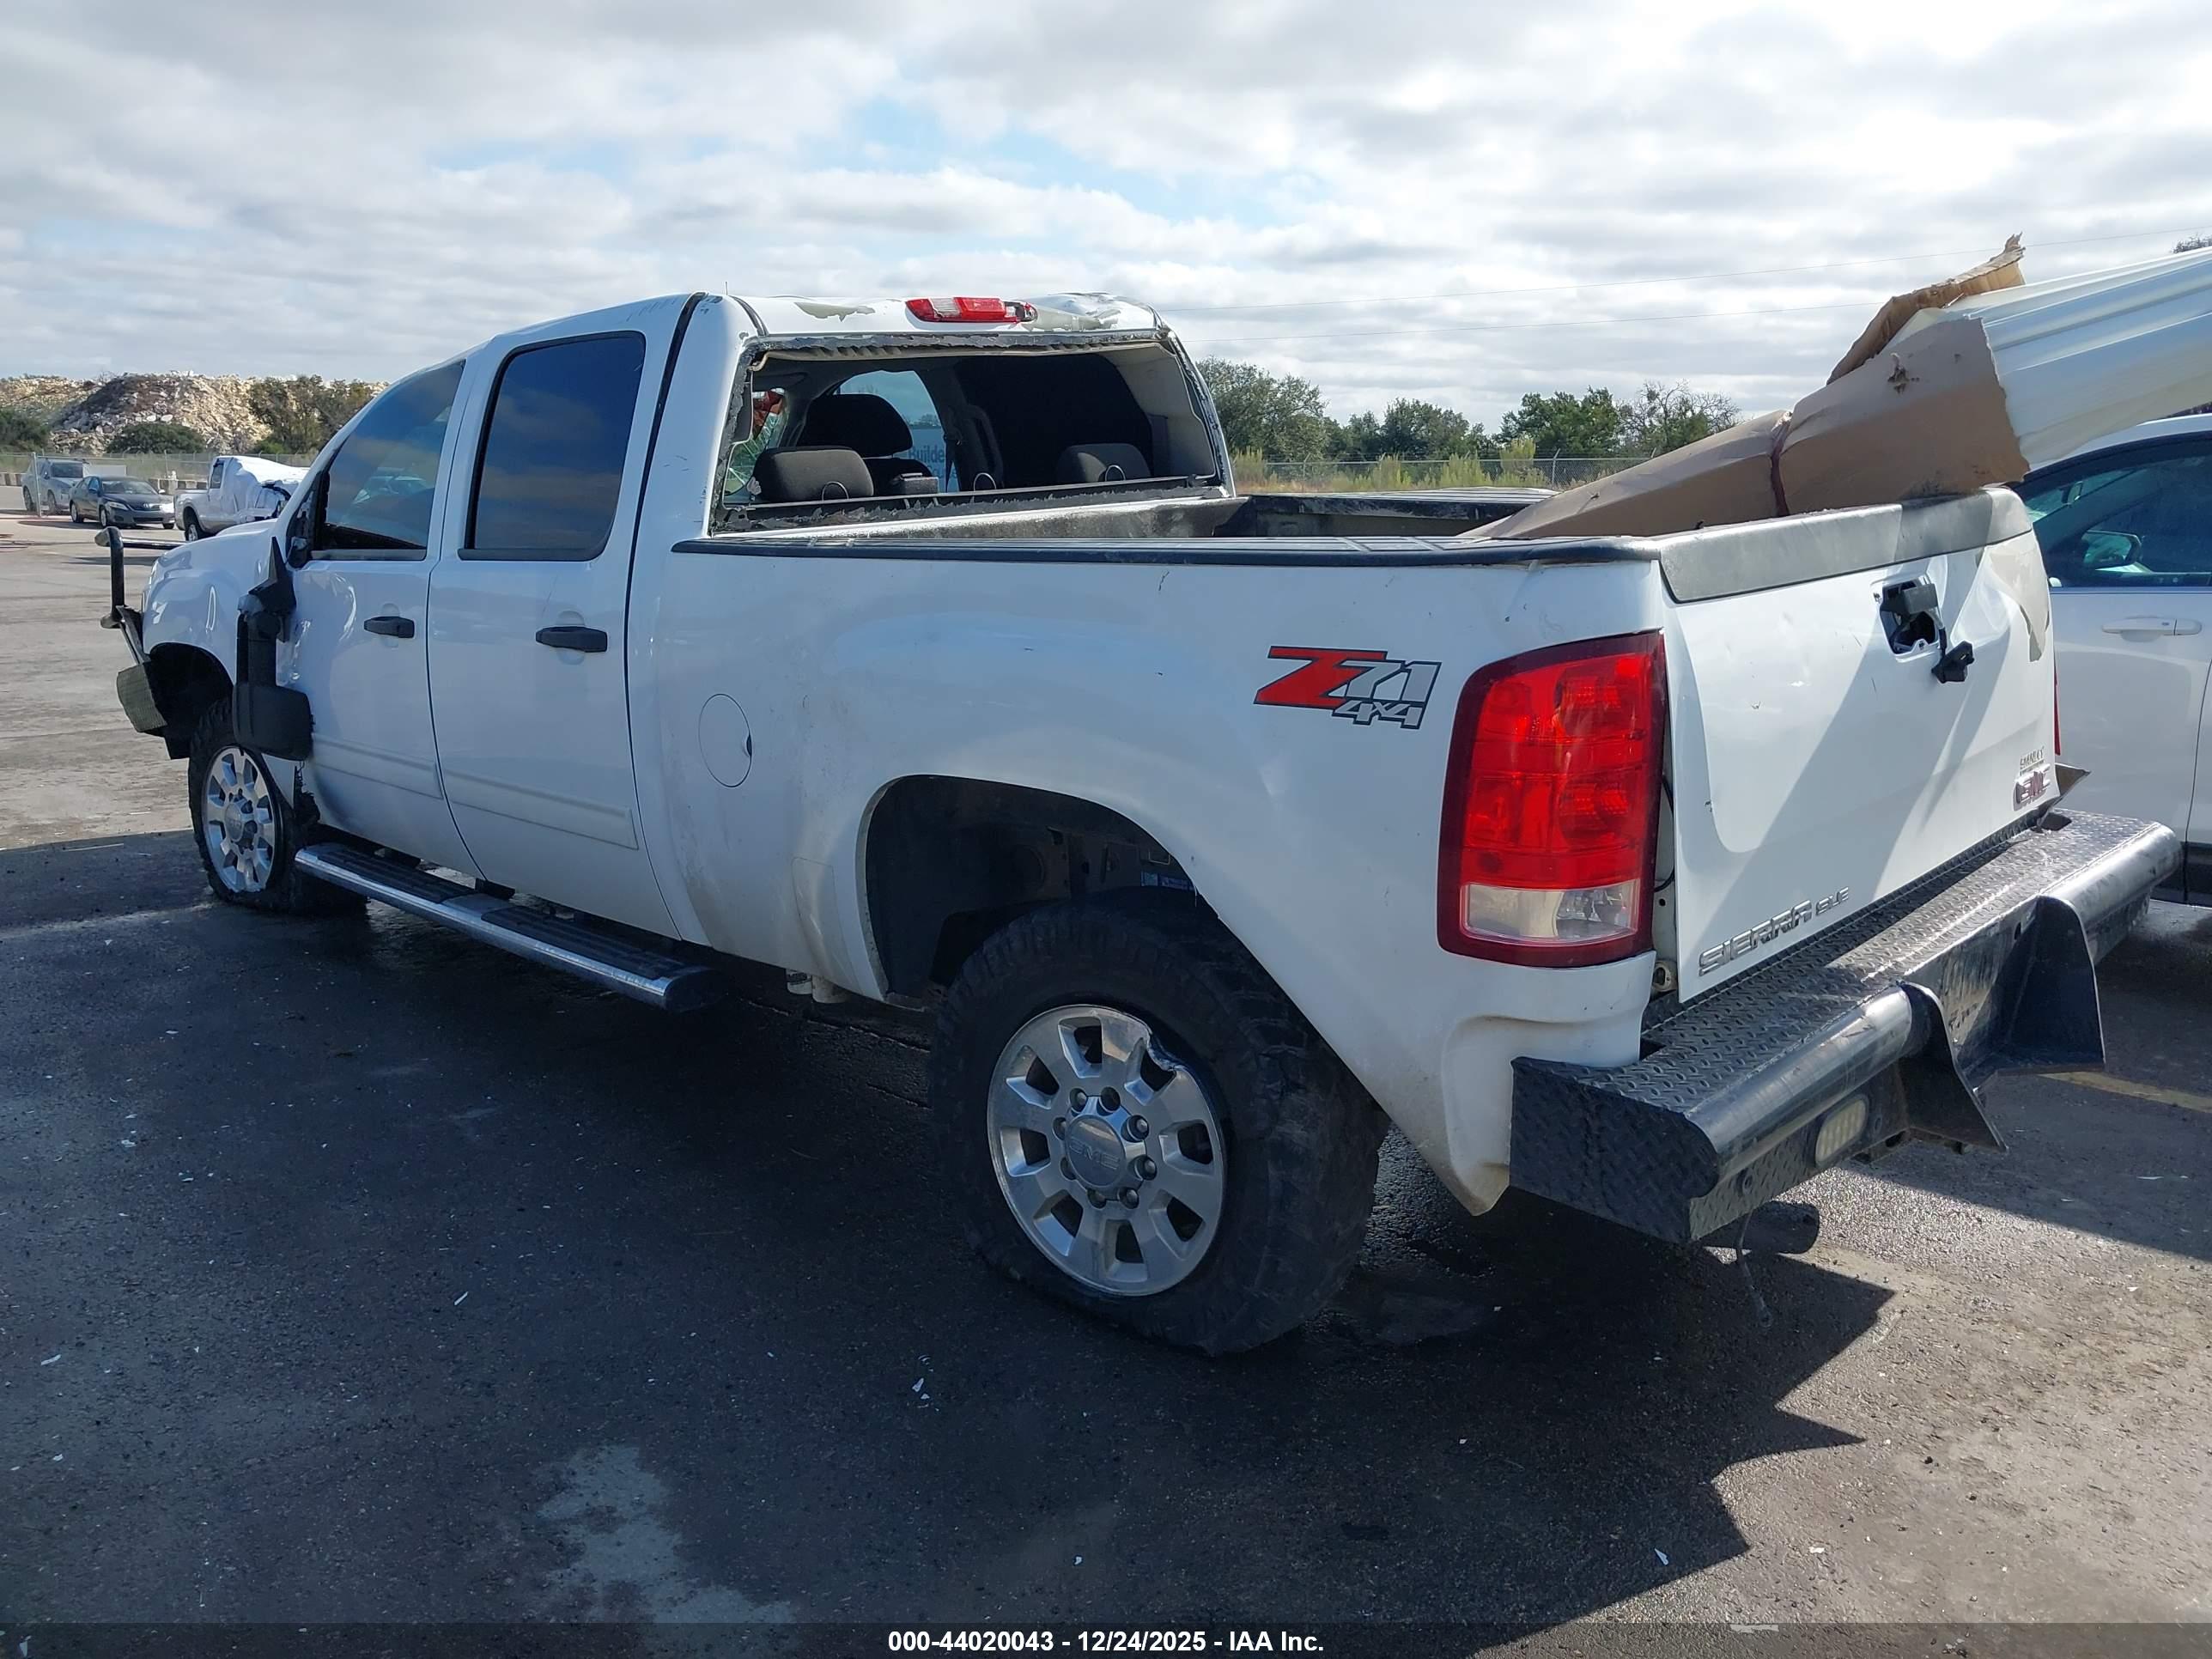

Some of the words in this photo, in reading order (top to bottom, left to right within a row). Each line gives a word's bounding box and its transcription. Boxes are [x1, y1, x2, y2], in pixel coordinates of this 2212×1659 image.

[1253, 646, 1442, 710] Z71
[1698, 899, 1813, 977] SIERRA
[1815, 886, 1849, 916] SLE
[1068, 1135, 1121, 1171] GMC
